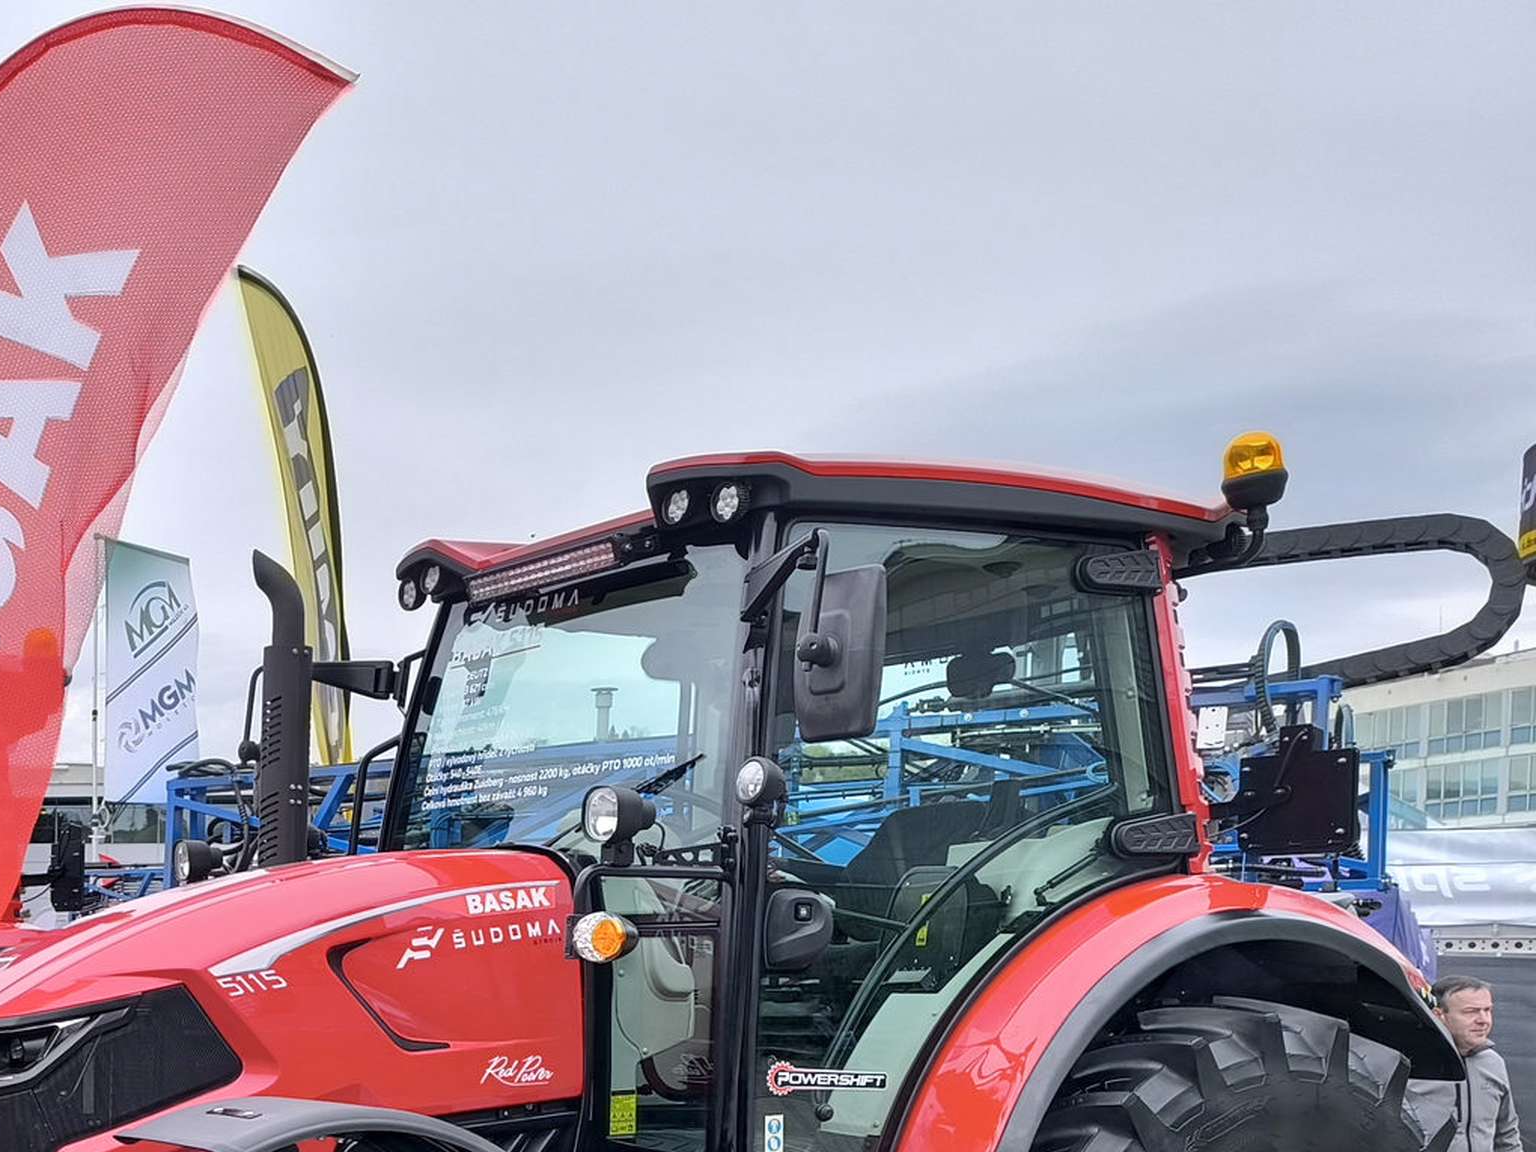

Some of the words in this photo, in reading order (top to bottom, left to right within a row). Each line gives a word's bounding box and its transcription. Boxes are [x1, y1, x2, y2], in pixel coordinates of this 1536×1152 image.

[138, 668, 196, 730] MGM
[539, 768, 558, 780] 2200
[602, 759, 622, 772] PTO
[622, 756, 643, 770] 1000
[466, 887, 552, 915] BASAK
[217, 968, 288, 998] 5115
[480, 1055, 516, 1085] Red
[776, 1070, 886, 1088] POWERSHIFT
